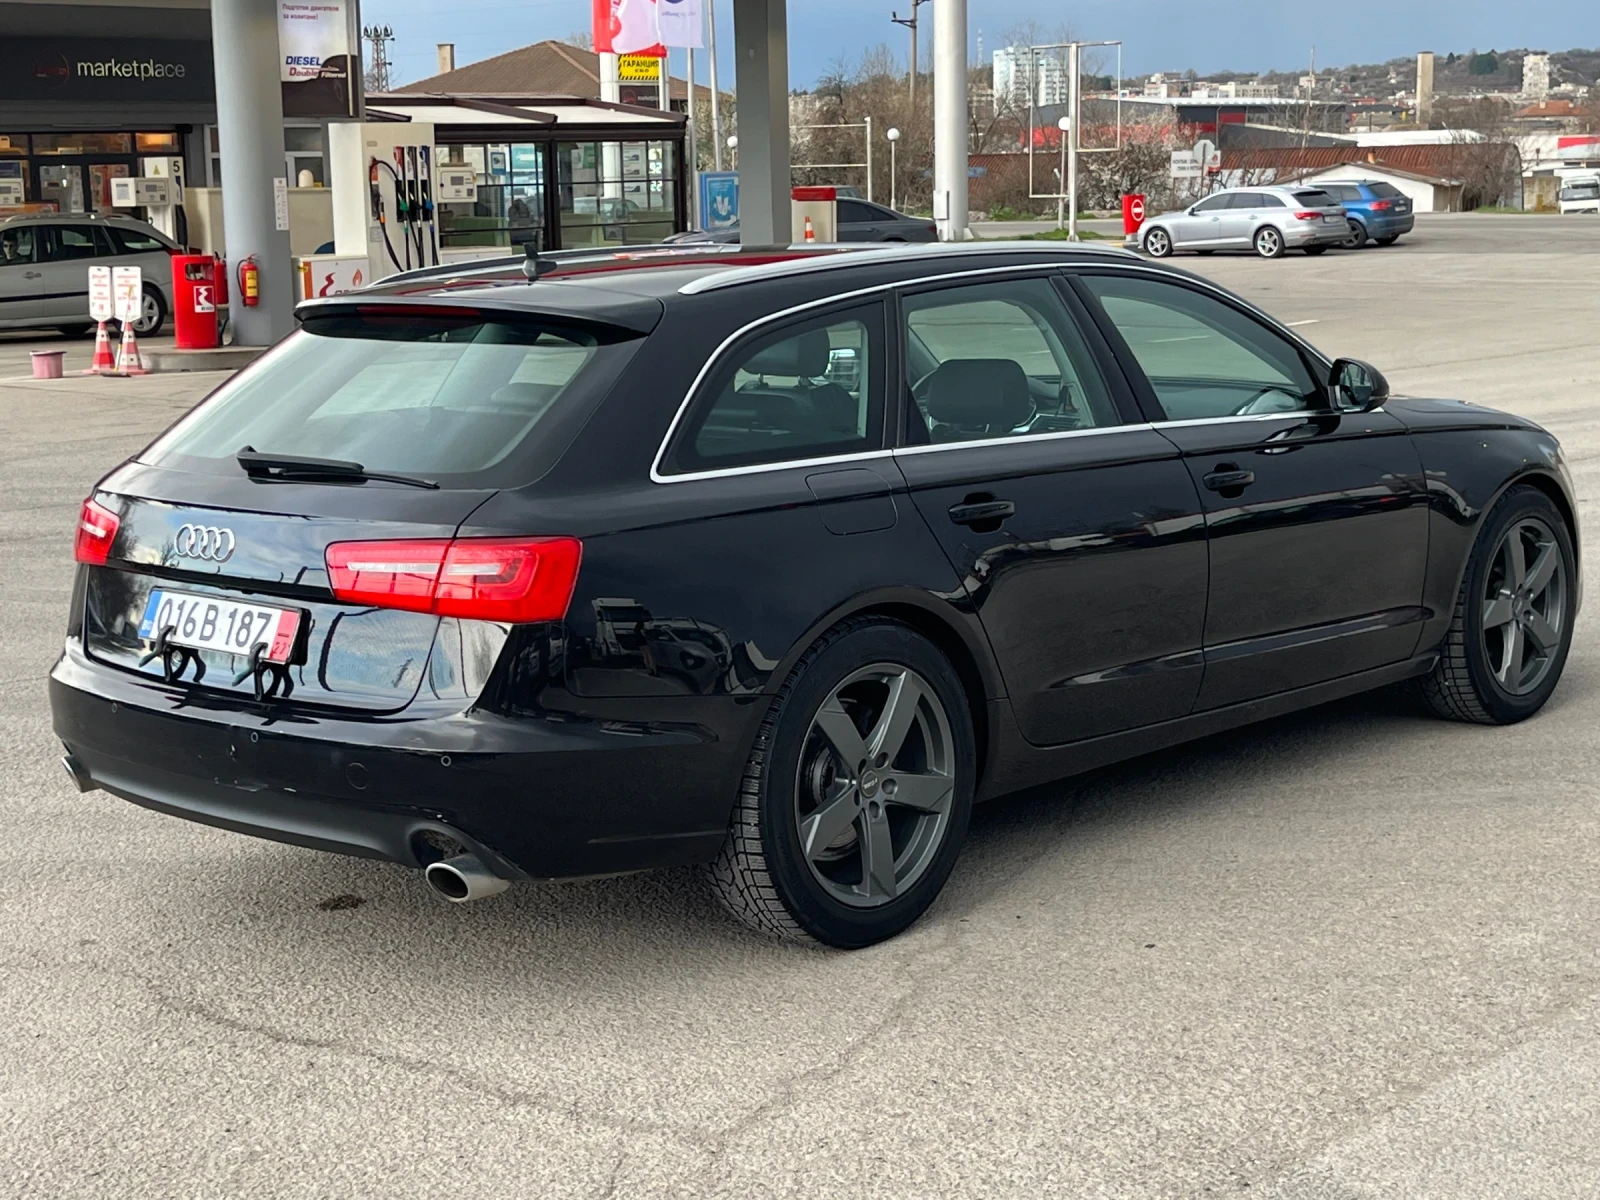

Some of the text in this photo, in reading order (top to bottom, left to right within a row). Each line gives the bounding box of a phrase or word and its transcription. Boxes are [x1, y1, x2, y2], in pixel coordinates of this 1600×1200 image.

[286, 56, 322, 66] DIESEL
[623, 60, 660, 68] ГАРАНЦИЯ
[77, 58, 186, 82] marketplace
[289, 66, 318, 78] Double
[172, 160, 181, 173] 5
